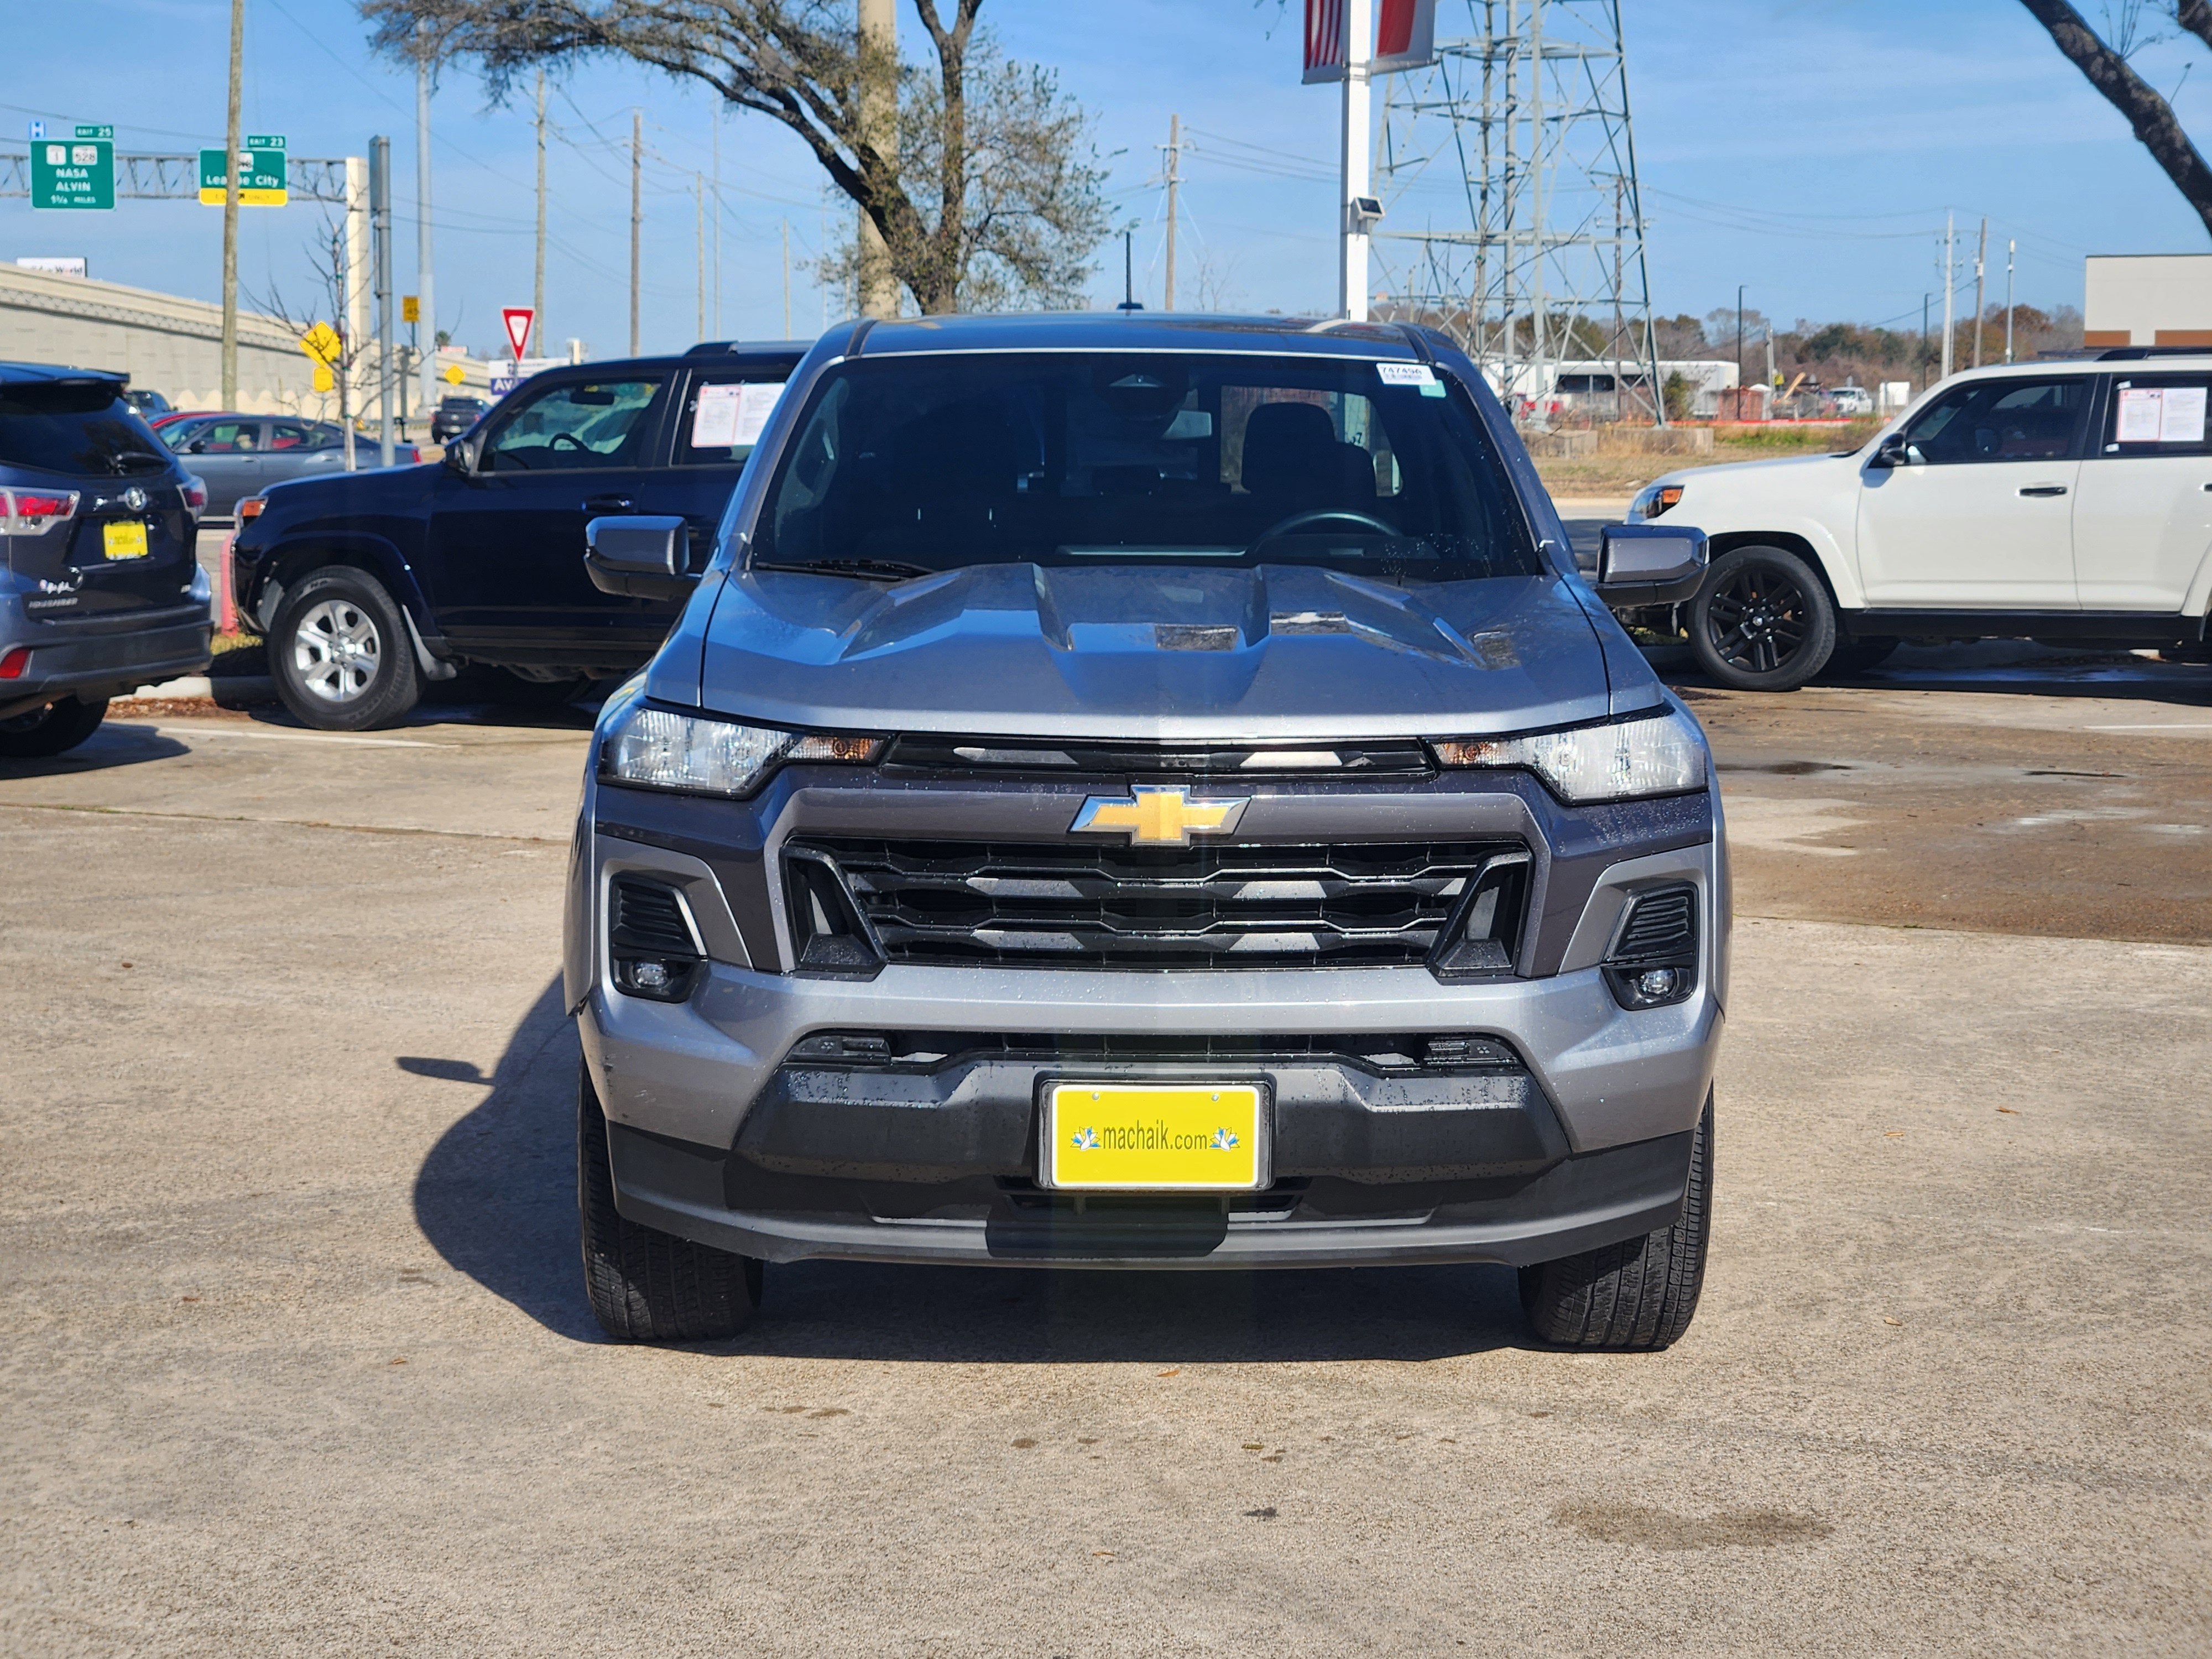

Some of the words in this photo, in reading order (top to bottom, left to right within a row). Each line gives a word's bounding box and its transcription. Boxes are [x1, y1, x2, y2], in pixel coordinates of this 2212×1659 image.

[75, 153, 96, 161] 528
[55, 168, 88, 178] NASA
[55, 181, 91, 192] ALVIN
[255, 174, 279, 188] City
[1103, 1119, 1208, 1150] machaik.com
